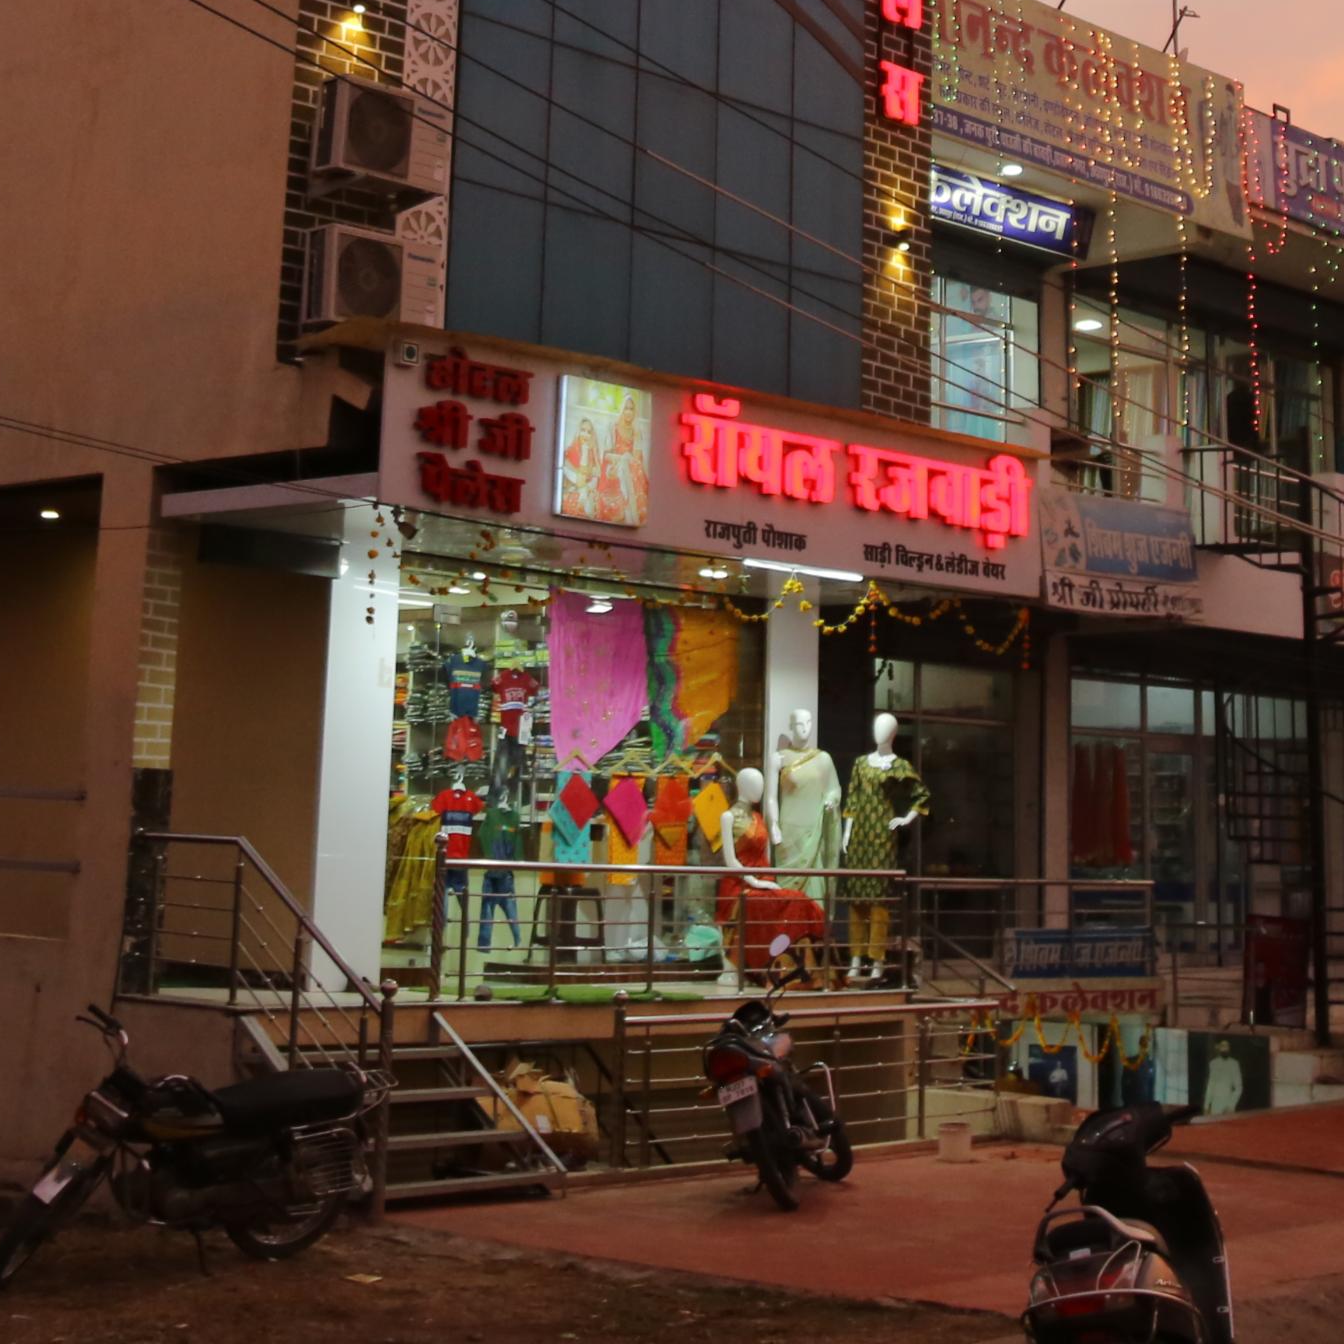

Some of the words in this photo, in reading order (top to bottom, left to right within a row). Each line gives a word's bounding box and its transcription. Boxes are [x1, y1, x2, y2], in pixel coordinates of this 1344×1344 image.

[424, 346, 535, 405] होटल
[413, 399, 473, 450] श्री
[477, 412, 536, 462] जी
[681, 393, 842, 505] रॉयल
[847, 444, 1034, 549] रजवाड़ी
[704, 519, 757, 550] राजपुती
